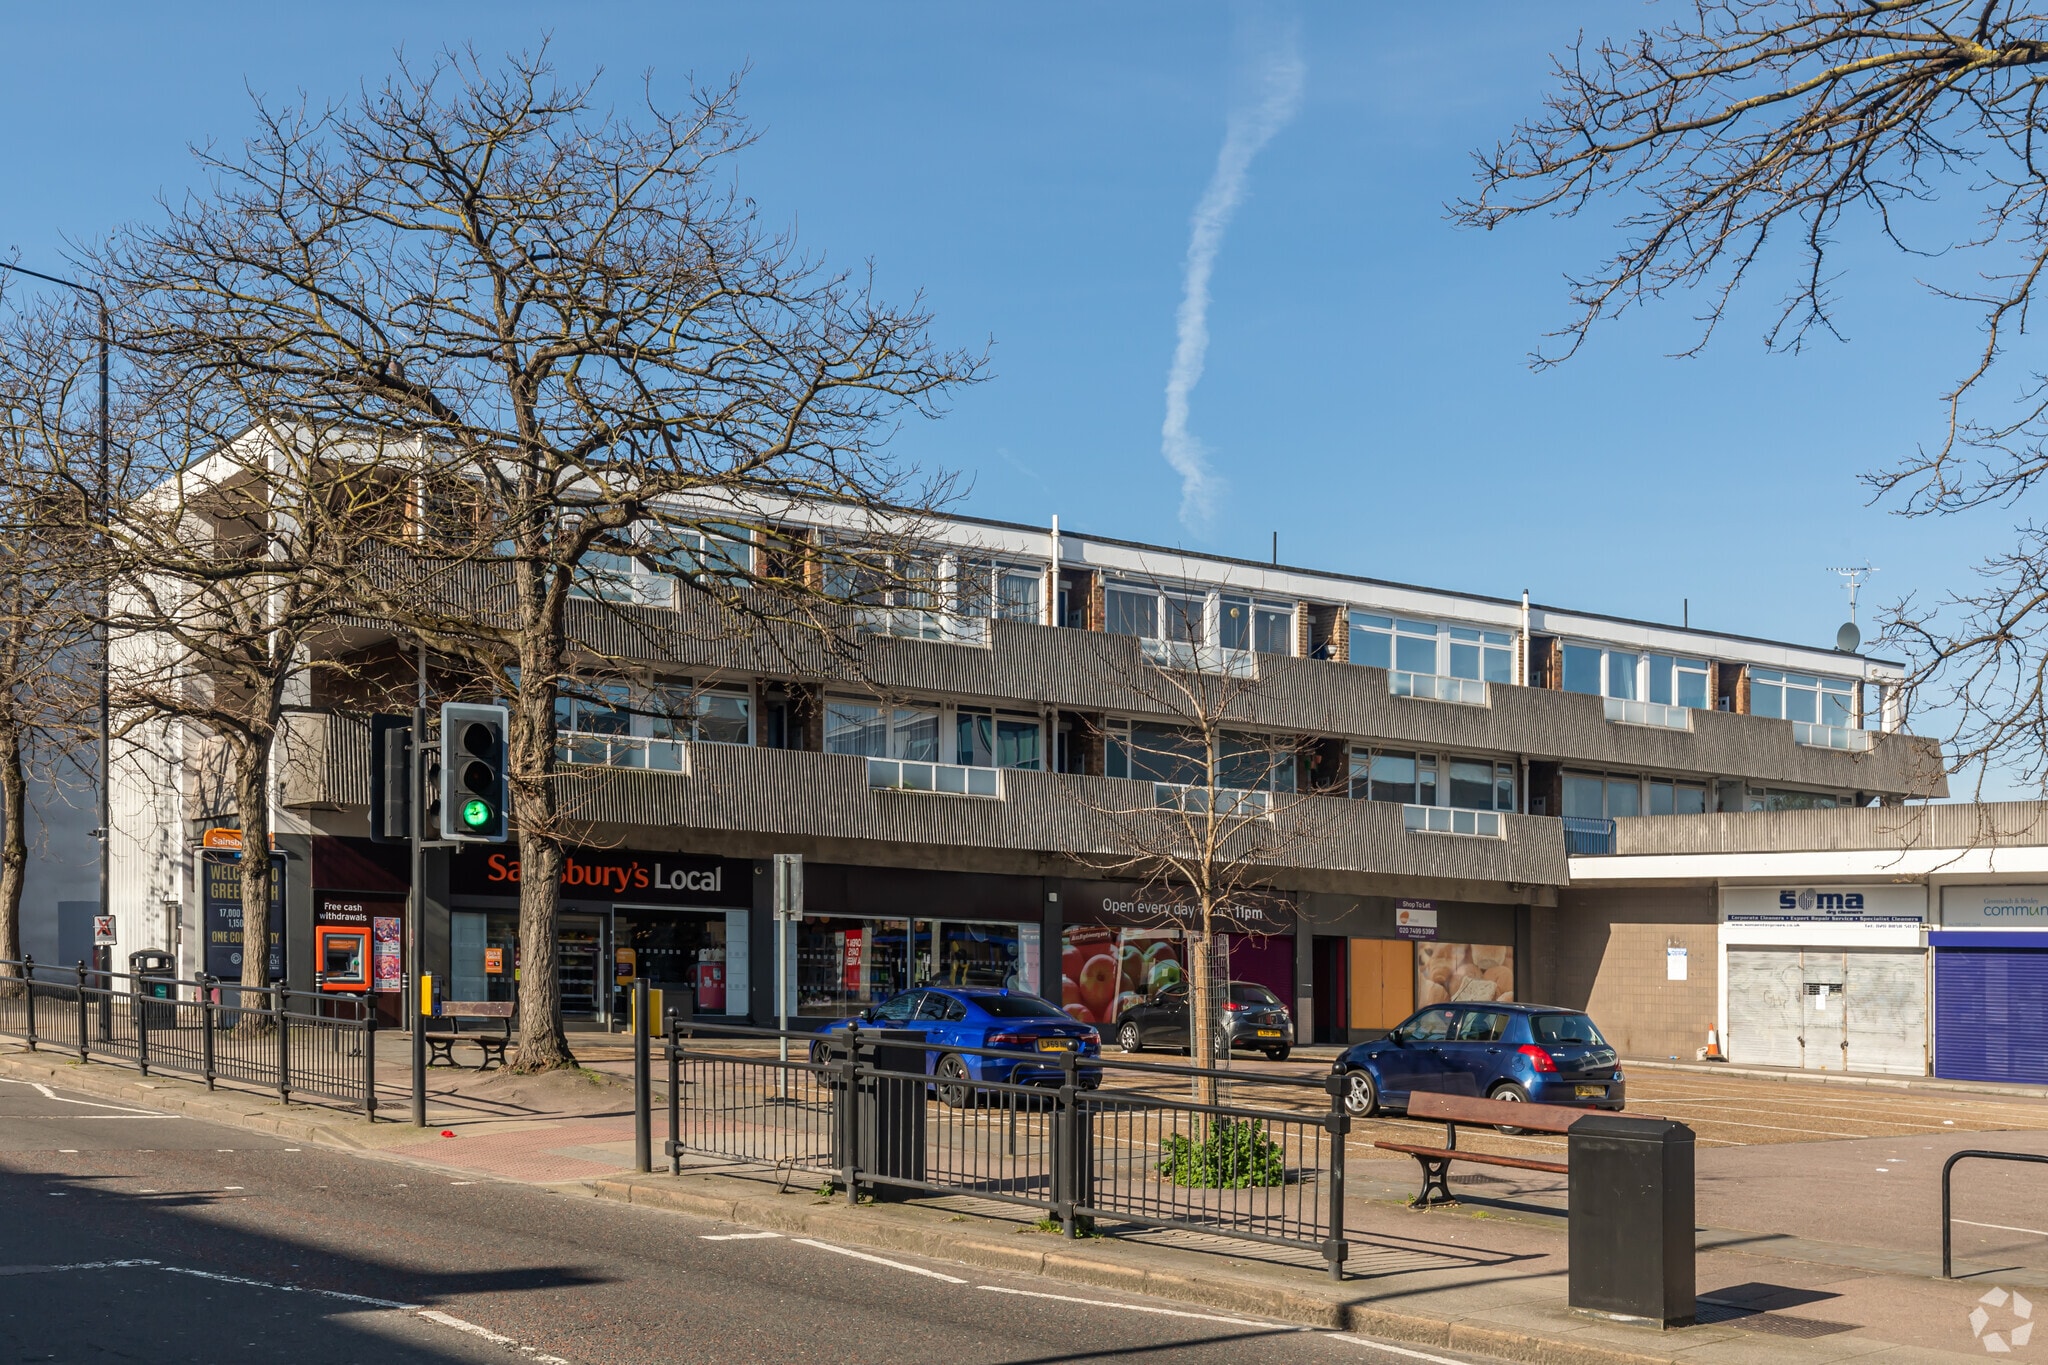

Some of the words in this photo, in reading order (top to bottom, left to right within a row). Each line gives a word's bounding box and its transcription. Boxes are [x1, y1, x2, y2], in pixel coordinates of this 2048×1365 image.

[487, 853, 649, 894] Sabury's
[654, 863, 722, 892] Local
[324, 902, 342, 911] Free
[343, 904, 363, 912] cash
[1102, 898, 1135, 914] Open
[1137, 902, 1171, 917] every
[1174, 902, 1195, 918] day
[1235, 905, 1263, 921] 11pm
[1402, 901, 1415, 909] Shop
[219, 908, 241, 918] 17,000
[319, 912, 367, 921] withdrawals
[211, 931, 228, 943] ONE
